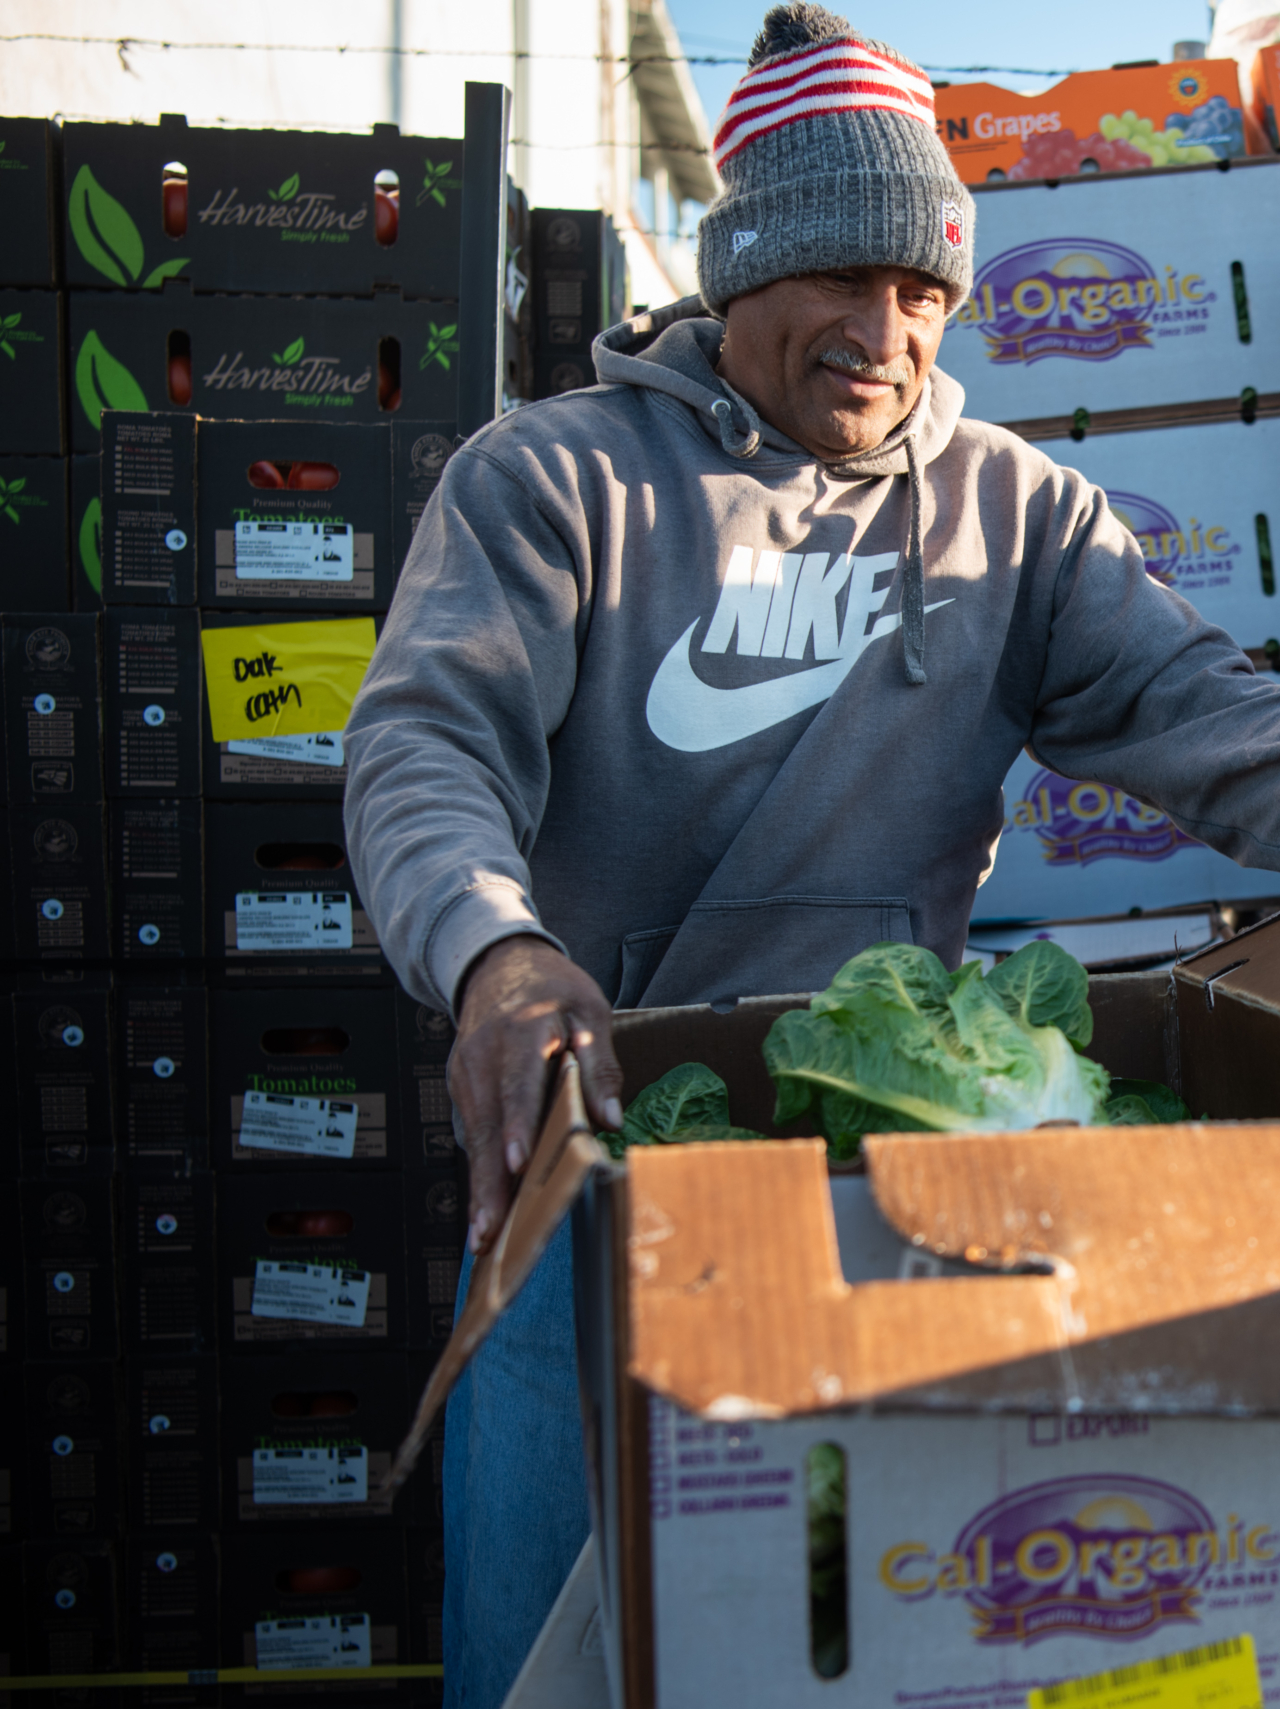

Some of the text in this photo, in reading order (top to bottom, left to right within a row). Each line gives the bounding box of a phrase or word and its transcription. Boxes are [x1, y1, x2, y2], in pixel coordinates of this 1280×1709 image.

[973, 112, 1061, 141] Grapes
[281, 229, 319, 243] Simply
[945, 221, 962, 246] NFL
[945, 265, 1206, 326] al-Organic
[1153, 308, 1209, 323] FARMS
[253, 498, 333, 510] Premium Quality
[1177, 560, 1233, 576] FARMS
[701, 545, 900, 661] NIKE
[248, 1073, 357, 1093] Tomatoes
[1067, 1413, 1149, 1441] EXPORT
[879, 1512, 1280, 1597] Cal-Organic
[1203, 1570, 1280, 1592] FARMS
